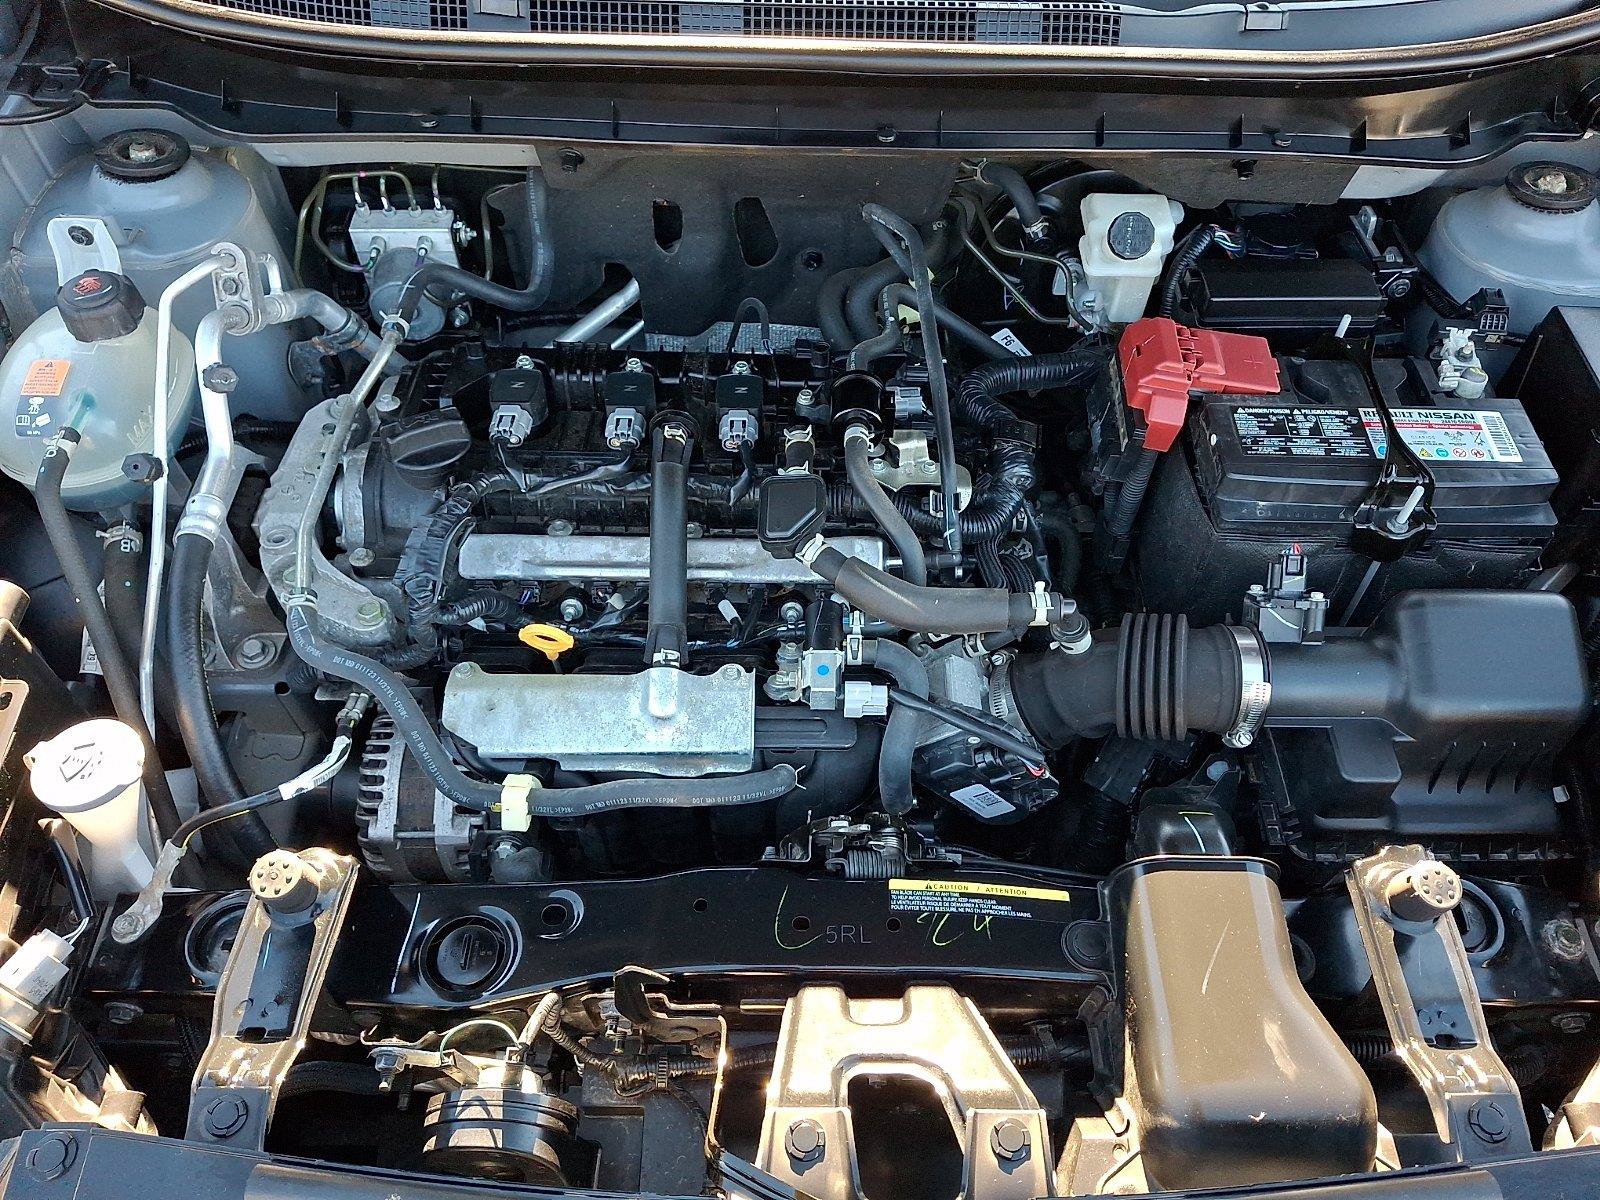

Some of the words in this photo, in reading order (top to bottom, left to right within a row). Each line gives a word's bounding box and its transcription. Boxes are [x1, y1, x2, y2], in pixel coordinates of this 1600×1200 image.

[1001, 335, 1015, 346] F6
[1417, 412, 1475, 420] NISSAN
[934, 883, 968, 891] CAUTION
[985, 887, 1027, 896] ATTENTION
[826, 925, 872, 944] 5RL
